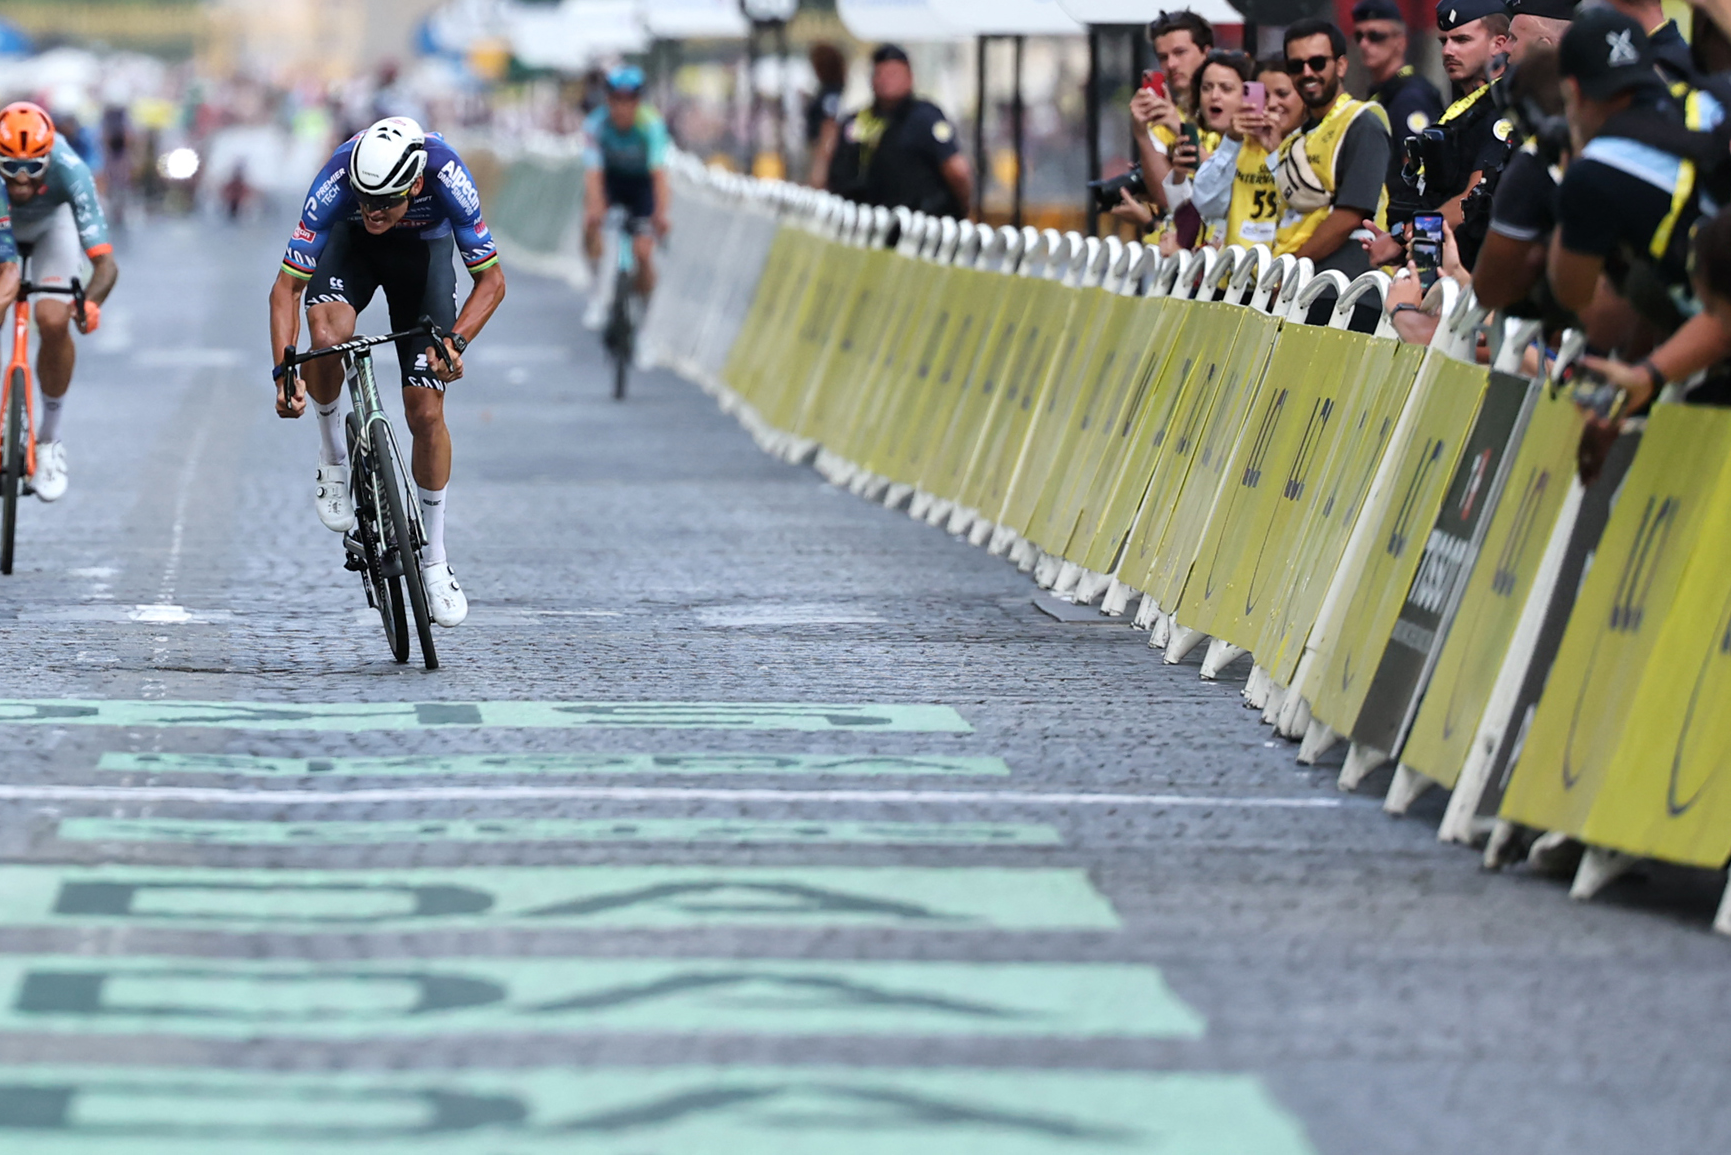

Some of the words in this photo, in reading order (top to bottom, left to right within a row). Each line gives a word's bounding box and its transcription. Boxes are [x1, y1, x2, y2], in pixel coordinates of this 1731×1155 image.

[315, 167, 346, 200] PREMIER
[320, 184, 341, 206] TECH
[440, 159, 481, 212] Alpecin
